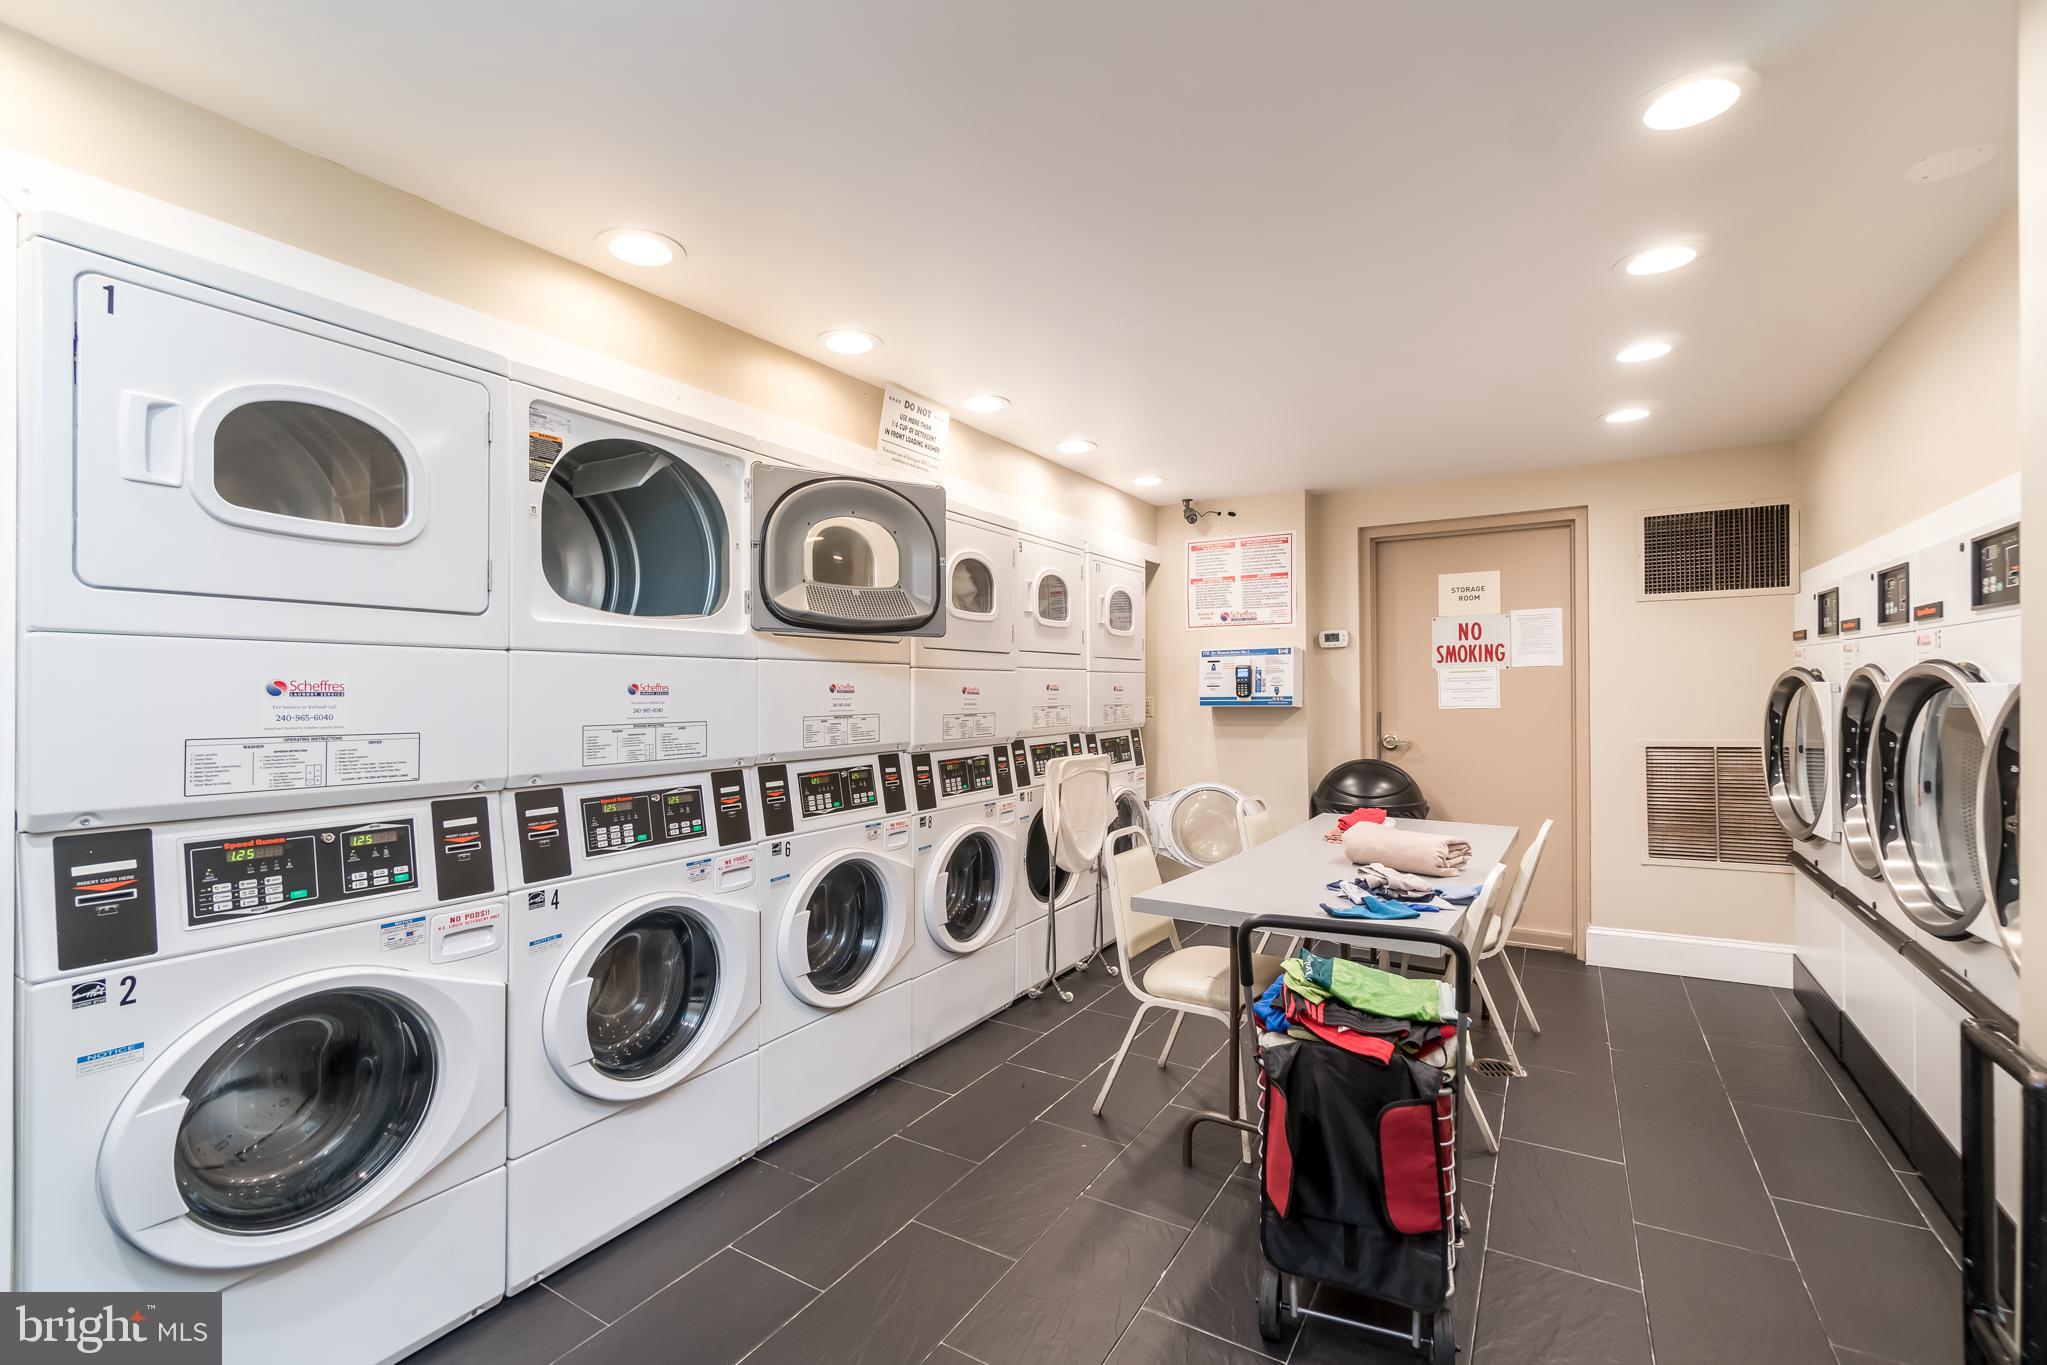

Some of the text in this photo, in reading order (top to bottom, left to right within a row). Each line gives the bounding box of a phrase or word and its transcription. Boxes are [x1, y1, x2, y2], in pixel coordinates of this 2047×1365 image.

[103, 285, 114, 314] 1
[904, 400, 932, 418] DO NOT
[899, 423, 908, 431] CUP
[900, 413, 931, 431] USE MORE THAN
[890, 429, 905, 440] FRONT
[905, 436, 924, 448] LOADING
[1458, 622, 1482, 641] NO
[1436, 643, 1505, 663] SMOKING
[290, 680, 345, 691] Scheffres
[640, 683, 669, 691] Scheffres
[276, 714, 334, 722] 240-965-6040
[928, 816, 932, 828] 8
[224, 838, 285, 850] Speed Queen
[785, 842, 791, 857] 6
[551, 889, 560, 910] 4
[450, 910, 490, 924] NO PODS!!
[120, 975, 137, 1006] 2
[87, 1045, 136, 1061] NOTICE
